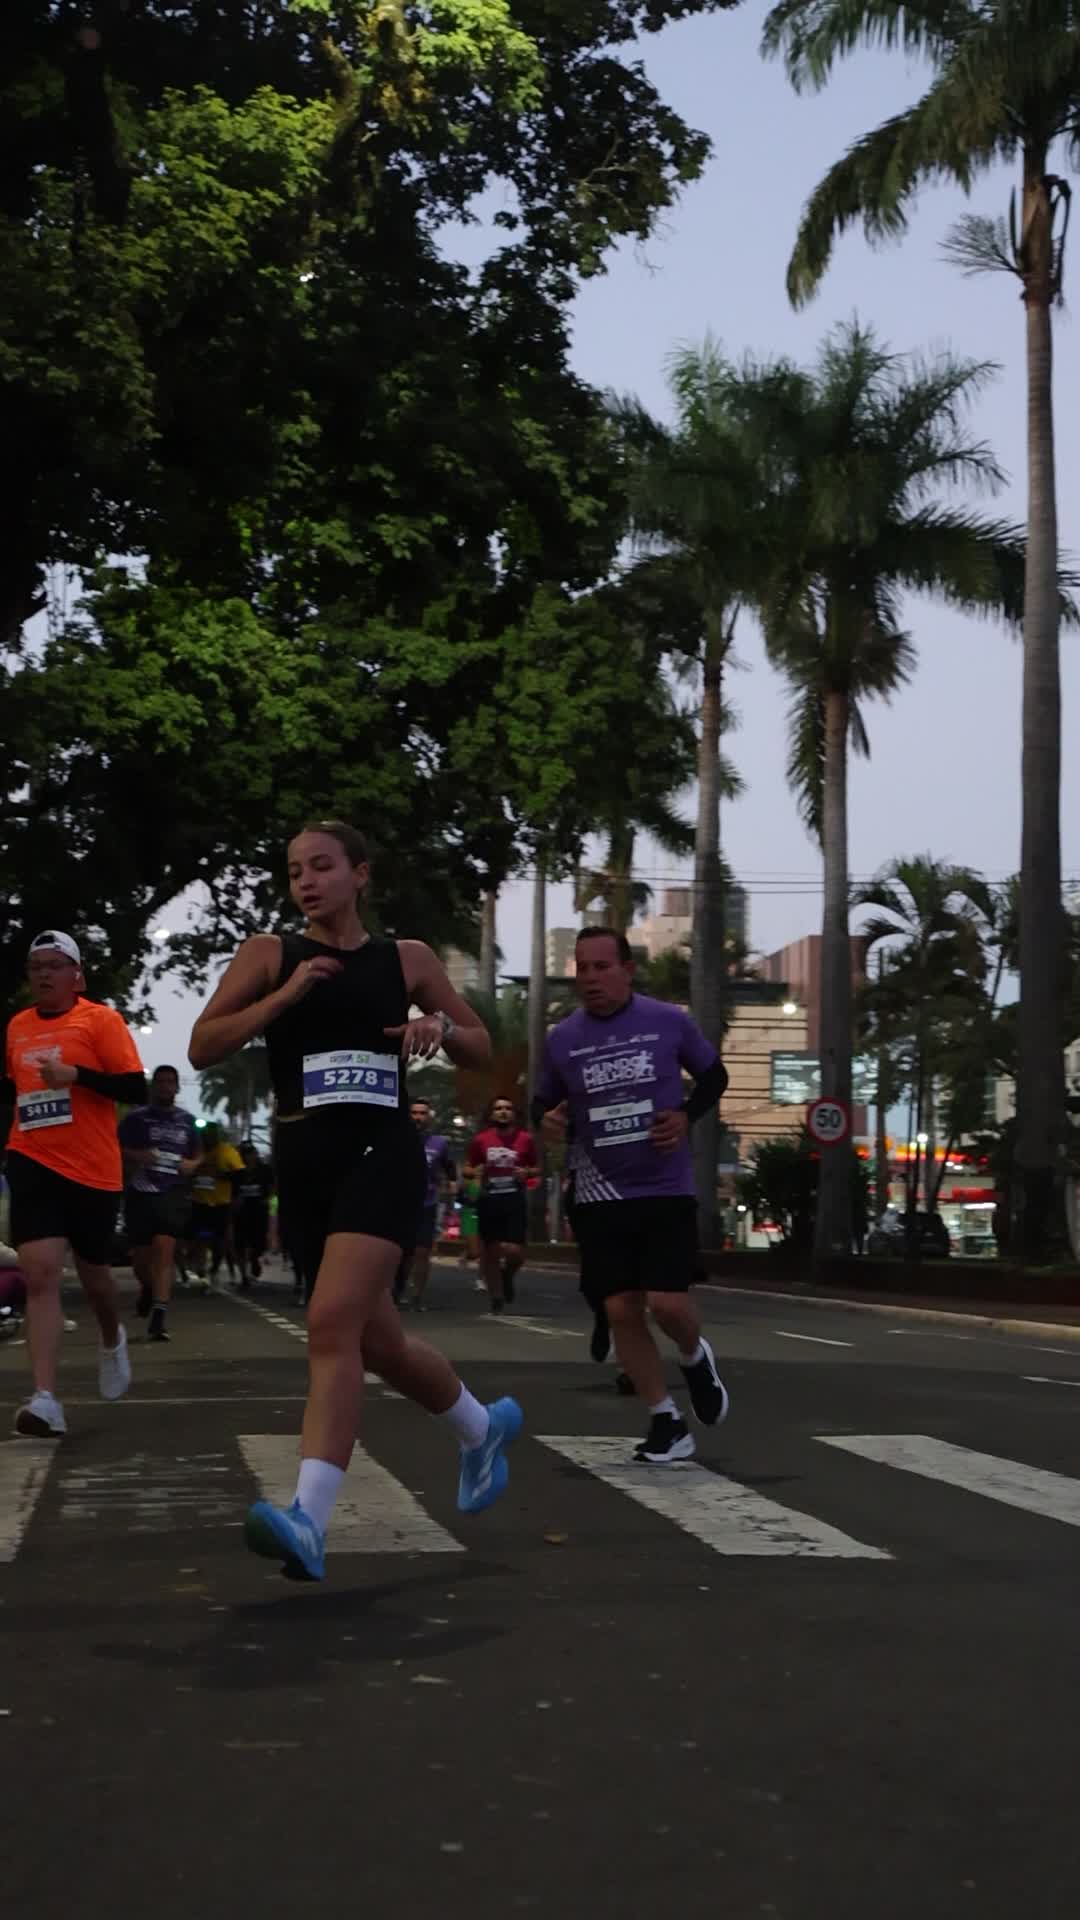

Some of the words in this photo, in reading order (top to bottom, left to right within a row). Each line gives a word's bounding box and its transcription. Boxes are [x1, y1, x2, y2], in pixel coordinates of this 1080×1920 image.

[323, 1069, 378, 1086] 5278
[26, 1101, 57, 1117] 5411
[603, 1115, 640, 1133] 6201
[816, 1109, 841, 1129] 50
